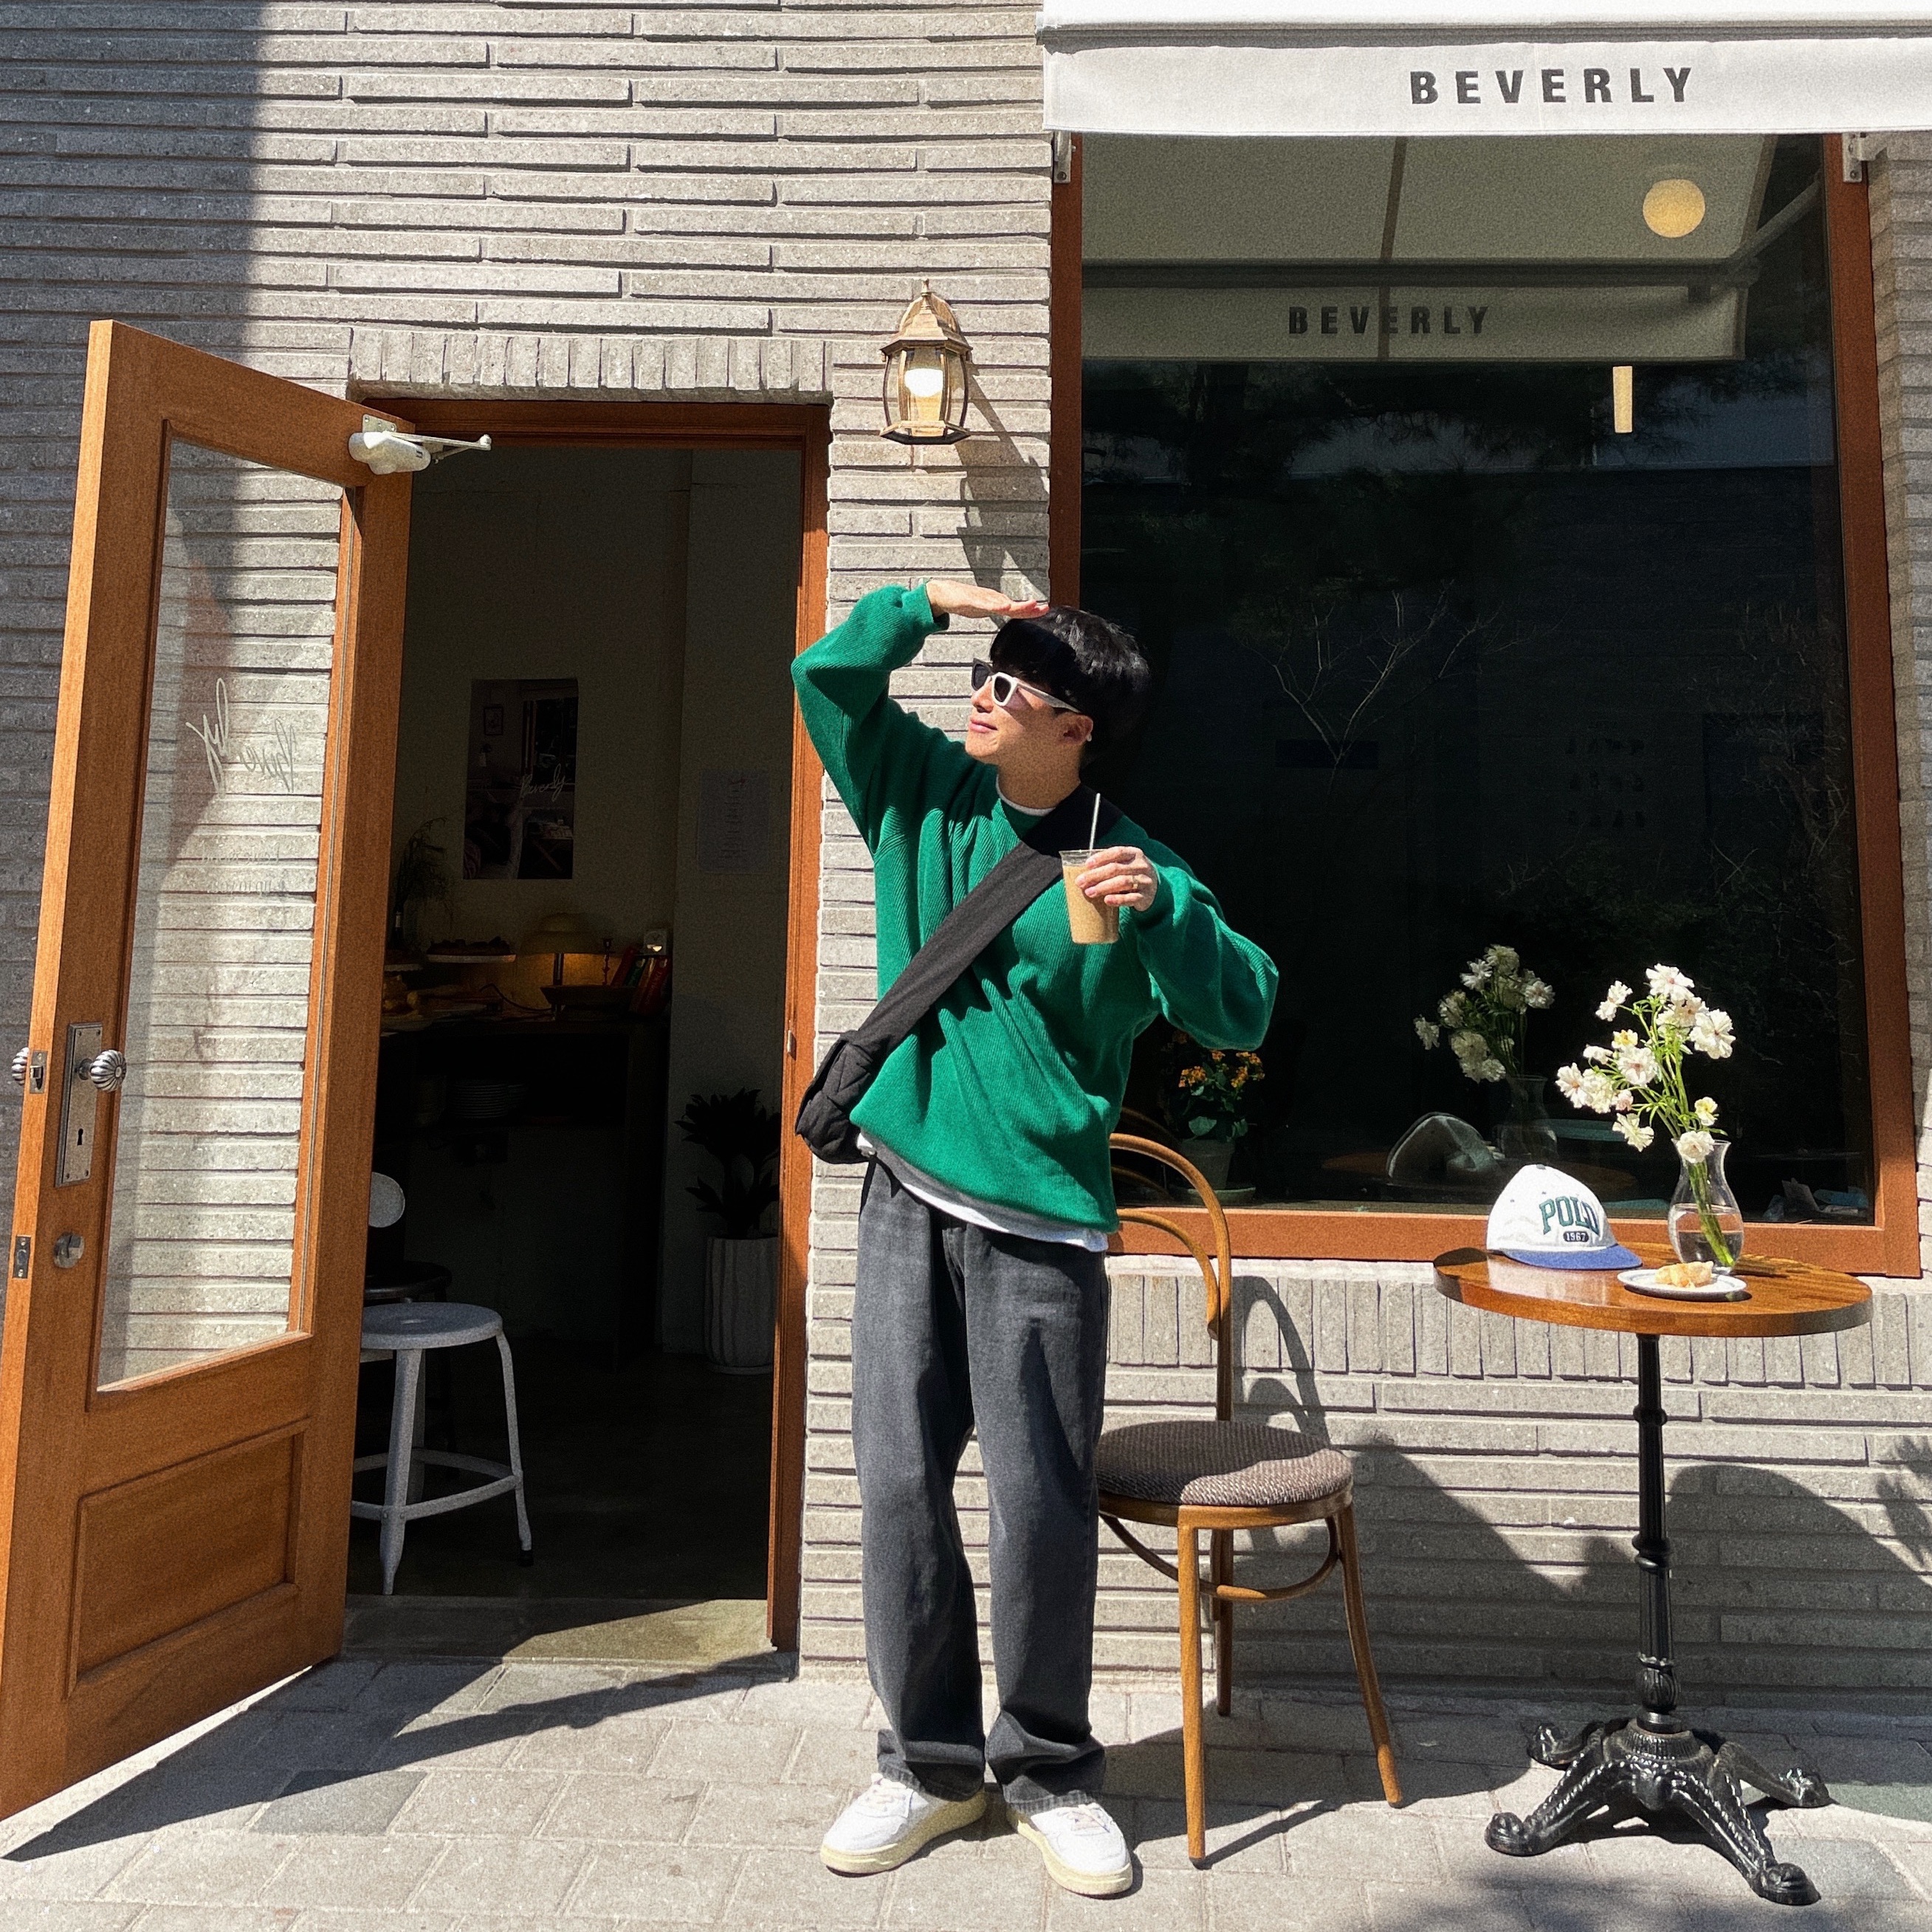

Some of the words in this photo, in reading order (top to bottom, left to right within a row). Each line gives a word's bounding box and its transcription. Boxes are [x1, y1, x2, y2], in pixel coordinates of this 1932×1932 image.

[1410, 68, 1691, 103] BEVERLY
[1288, 306, 1489, 334] BEVERLY
[1539, 1196, 1600, 1236] POLO
[1566, 1232, 1586, 1242] 1967
